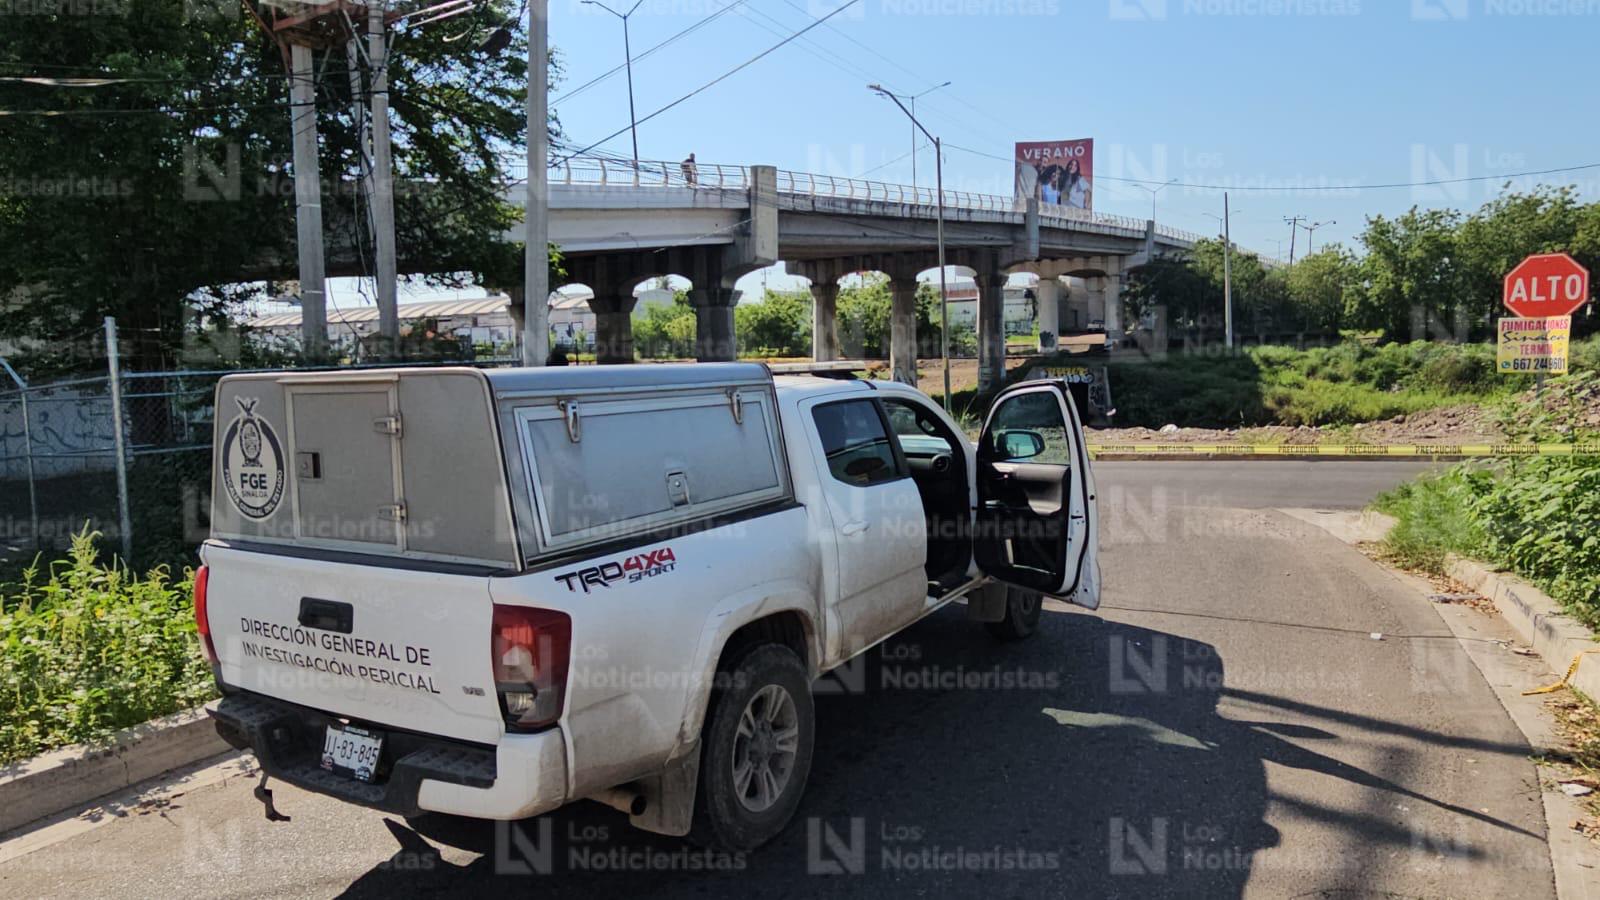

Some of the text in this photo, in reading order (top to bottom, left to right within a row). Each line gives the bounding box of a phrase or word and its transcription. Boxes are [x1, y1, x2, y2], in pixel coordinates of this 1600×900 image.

[1023, 146, 1085, 159] VERANO
[1509, 274, 1582, 302] ALTO
[1502, 319, 1568, 331] FUMIGACIONES
[1513, 358, 1532, 370] 667
[1278, 445, 1319, 453] PRECAUCION
[1344, 446, 1388, 454] PRECAUCION
[1415, 445, 1462, 454] PRECAUCION
[1490, 445, 1540, 454] PRECAUCION
[240, 473, 267, 489] FGE
[554, 562, 625, 594] TRD
[628, 562, 676, 583] SPORT
[241, 618, 431, 665] DIRECCIÓN GENERAL DE
[242, 641, 441, 694] INVESTIGACIÓN PERICIAL
